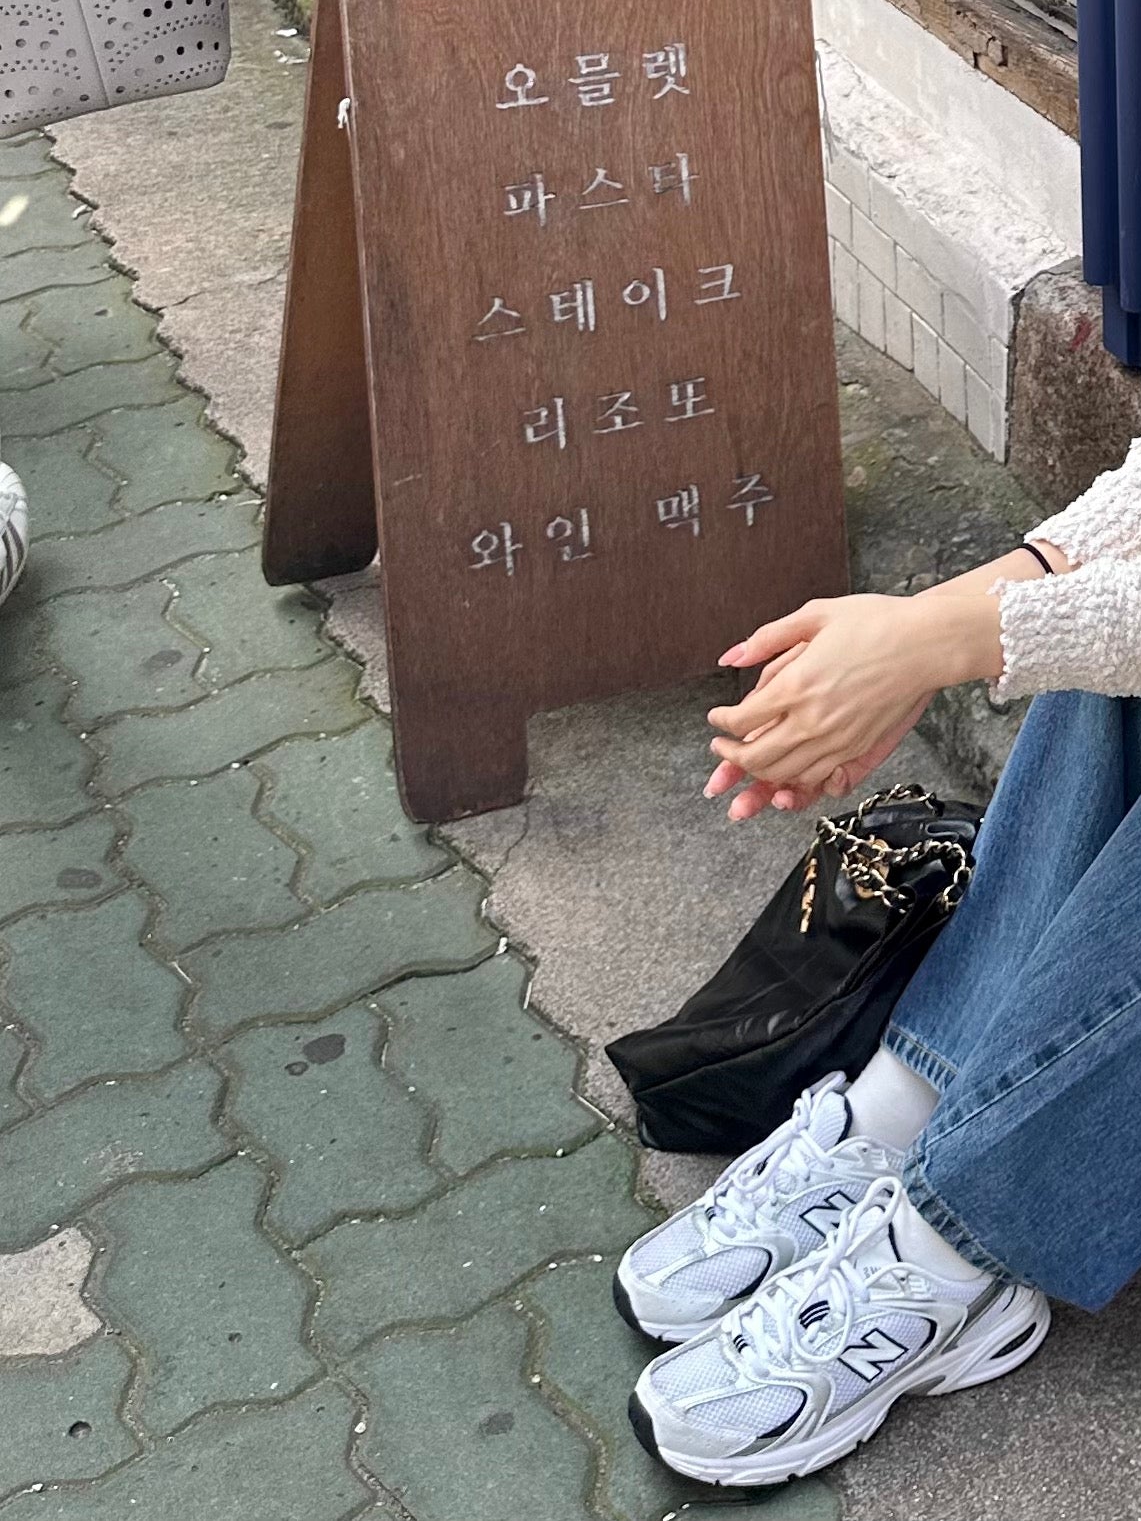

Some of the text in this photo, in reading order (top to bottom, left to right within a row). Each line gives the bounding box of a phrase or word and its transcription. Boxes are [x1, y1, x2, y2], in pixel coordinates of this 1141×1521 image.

[496, 43, 690, 109] 오믈렛
[502, 153, 699, 227] 파스타
[472, 263, 741, 341] 스테이크
[523, 377, 715, 449] 리조또
[469, 473, 774, 576] 와인 맥주
[837, 1327, 910, 1383] N
